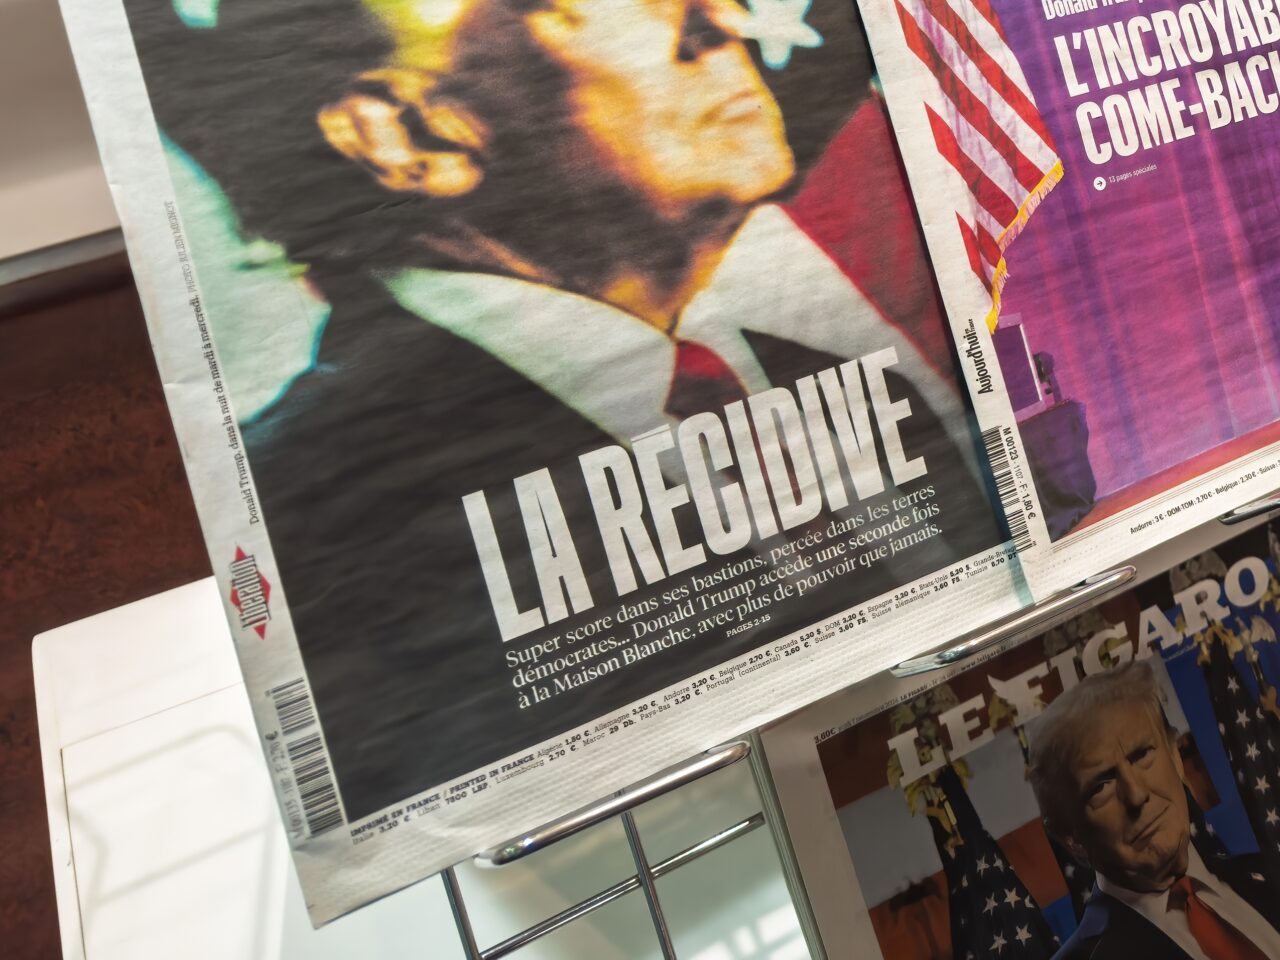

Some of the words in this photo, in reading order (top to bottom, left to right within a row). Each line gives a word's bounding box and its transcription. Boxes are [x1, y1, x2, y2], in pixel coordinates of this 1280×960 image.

[461, 467, 595, 643] LA
[578, 345, 929, 598] RÉCIDIVE
[505, 635, 560, 667] Super
[565, 616, 612, 643] score
[616, 597, 658, 622] dans
[662, 584, 689, 604] ses
[691, 555, 767, 591] bastions,
[768, 530, 823, 565] percée
[826, 514, 864, 538] dans
[866, 504, 889, 521] les
[891, 485, 935, 512] terres
[512, 636, 630, 687] démocrates...
[631, 599, 695, 638] Donald
[696, 578, 755, 610] Trump
[759, 554, 813, 586] accède
[815, 542, 846, 562] une
[848, 514, 910, 549] seconde
[911, 502, 939, 523] fois
[518, 691, 530, 708] à
[531, 685, 551, 702] la
[553, 657, 620, 694] Maison
[621, 627, 696, 665] Blanche,
[697, 608, 734, 633] avec
[735, 593, 771, 621] plus
[773, 583, 793, 601] de
[795, 556, 855, 596] pouvoir
[859, 545, 887, 567] que
[888, 522, 942, 555] jamais.
[725, 620, 753, 637] PAGES
[753, 613, 770, 625] 2-15
[886, 692, 995, 785] LE
[987, 555, 1270, 717] FIGARO
